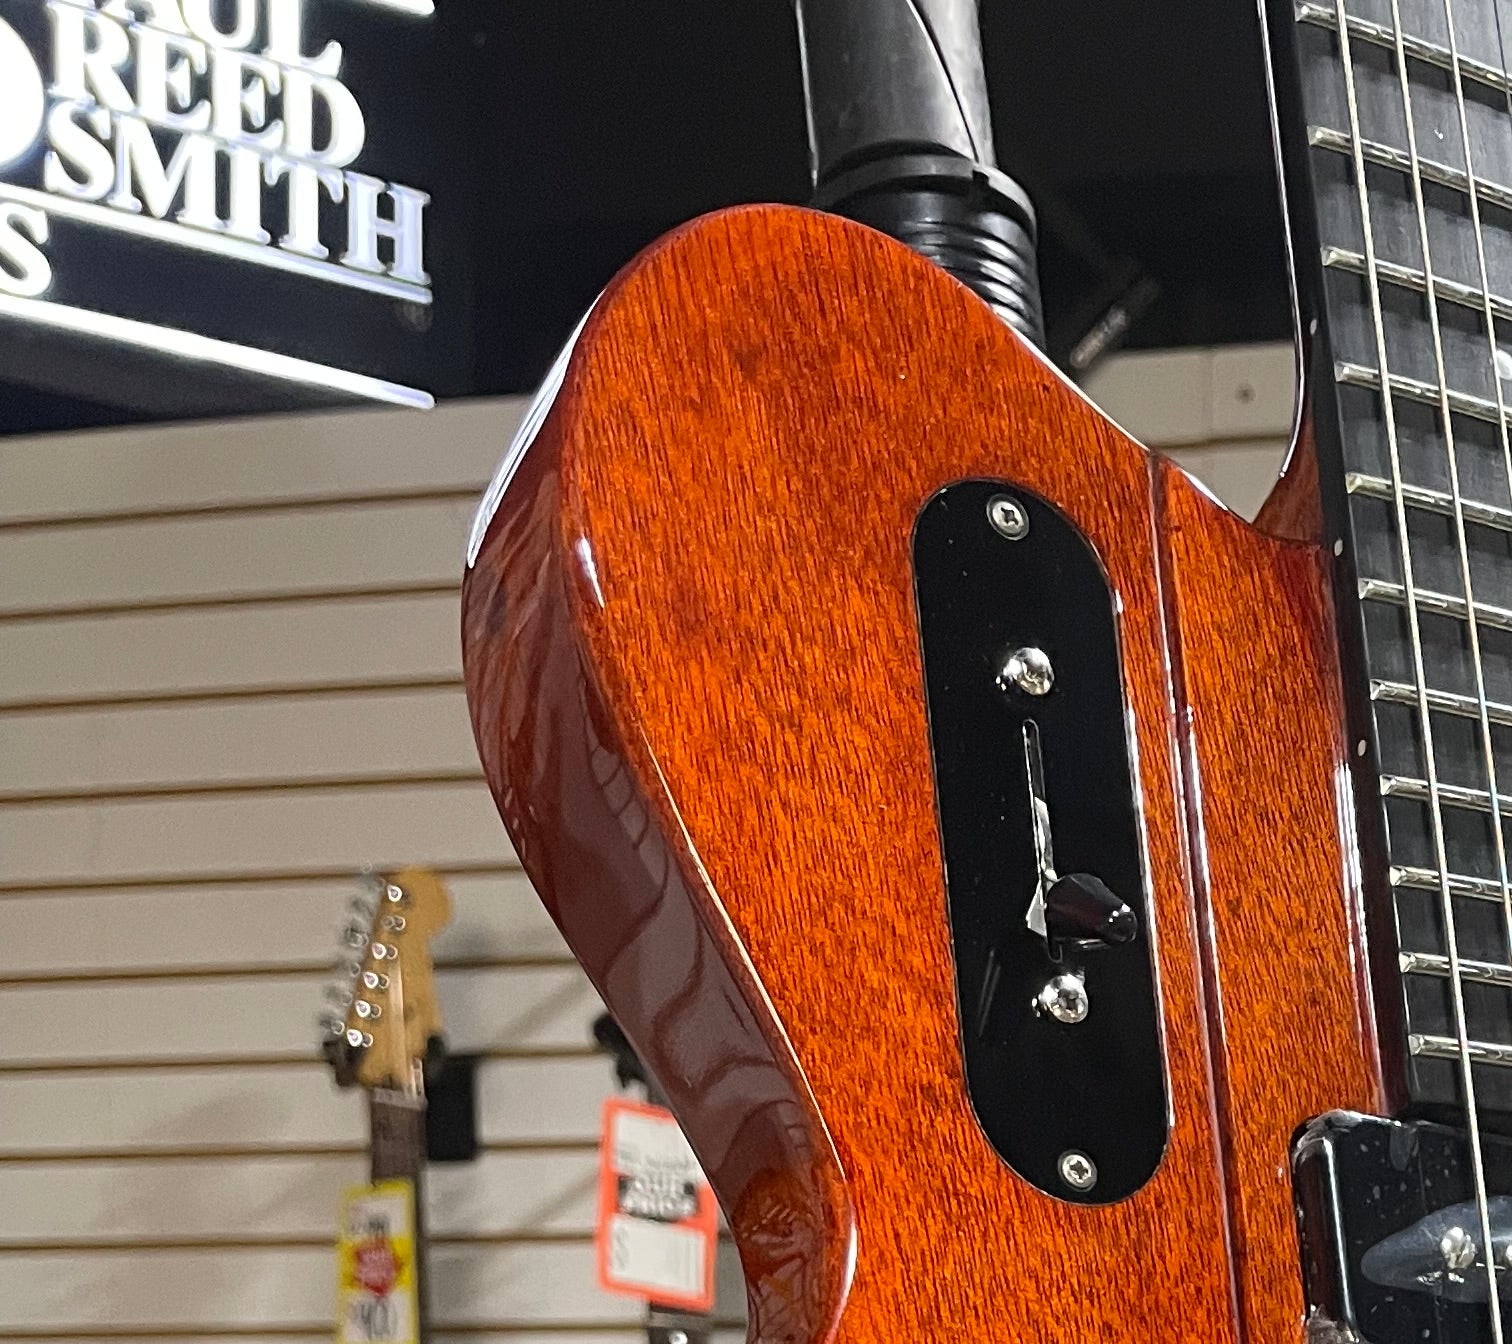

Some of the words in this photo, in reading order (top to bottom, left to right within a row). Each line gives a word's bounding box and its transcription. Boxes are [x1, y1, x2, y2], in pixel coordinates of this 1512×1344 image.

[46, 2, 367, 168] REED
[56, 0, 343, 77] UL
[44, 99, 432, 286] SMITH
